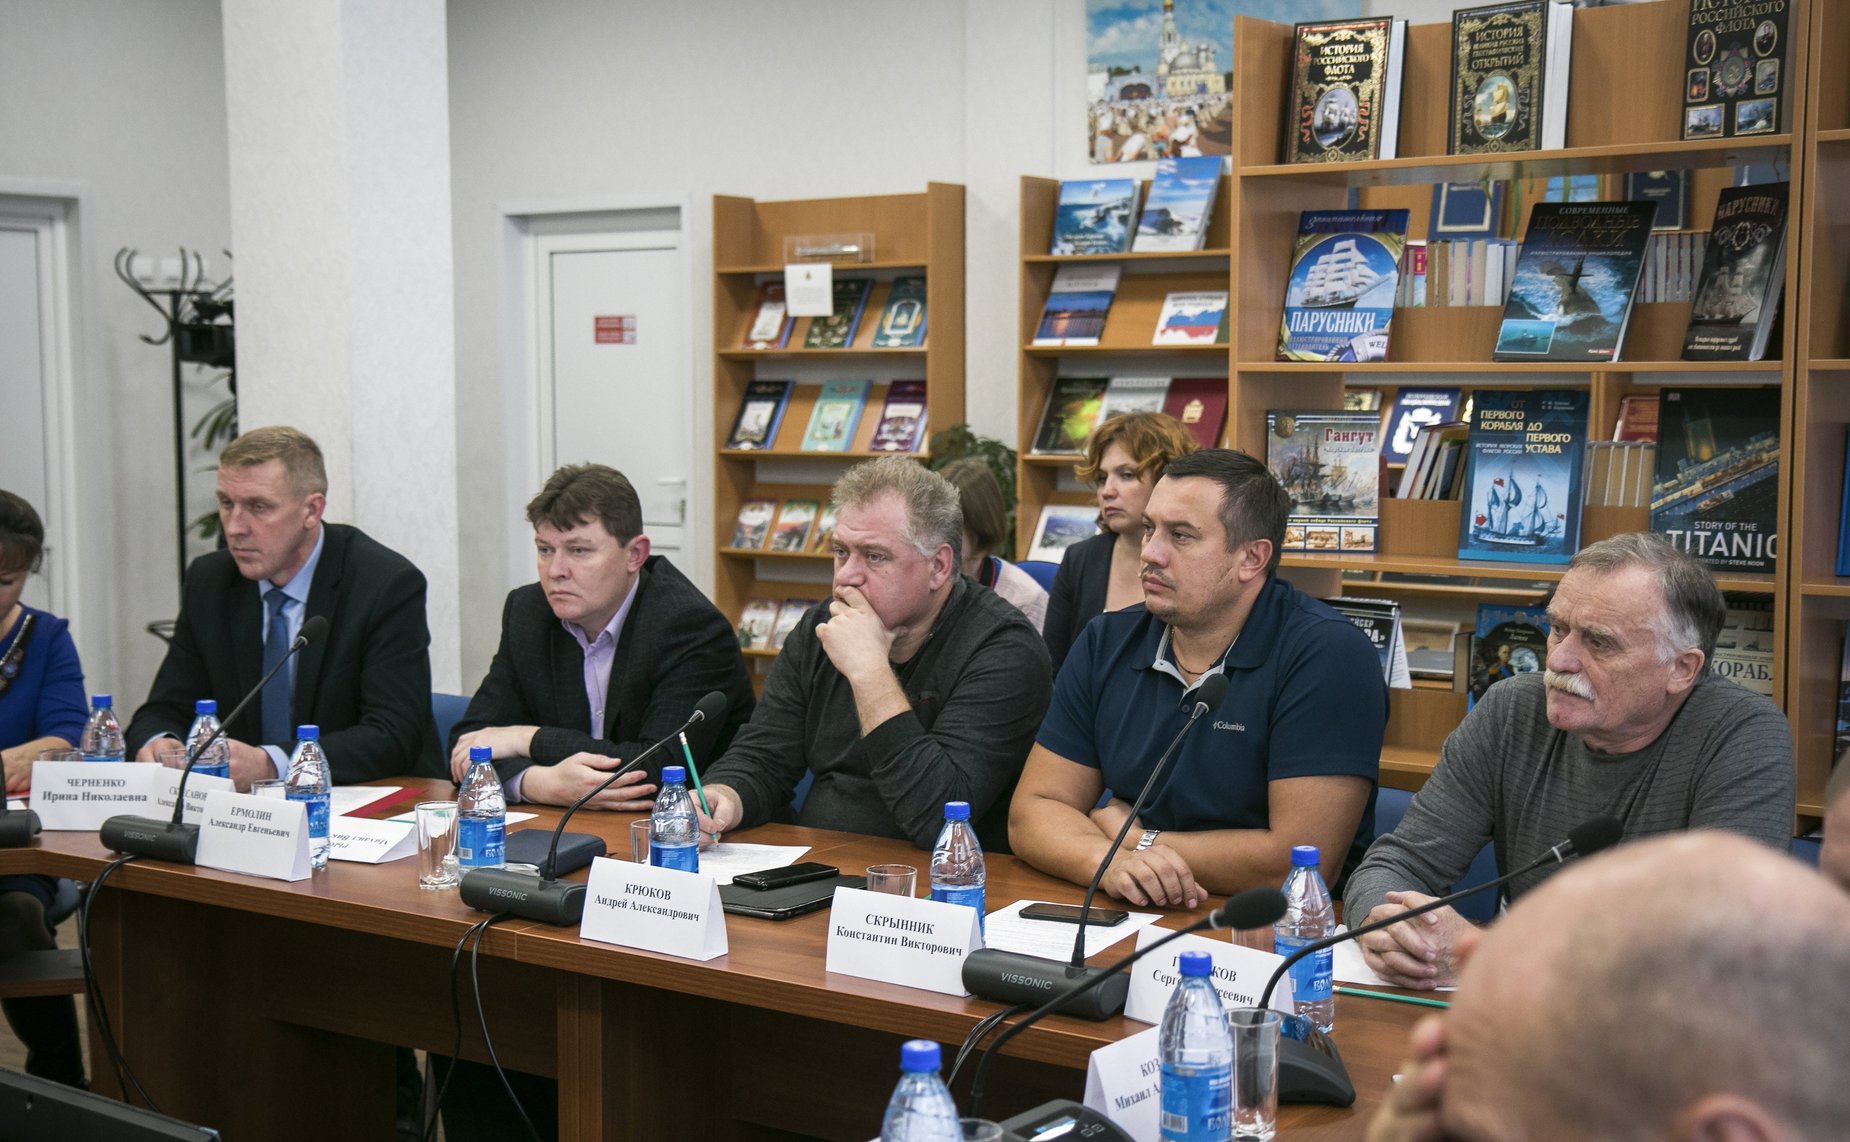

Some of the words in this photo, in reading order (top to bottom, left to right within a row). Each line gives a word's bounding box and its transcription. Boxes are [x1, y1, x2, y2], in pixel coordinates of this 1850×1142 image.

[1691, 1, 1785, 25] РОССИЙСКОГО
[1715, 18, 1756, 33] ФЛОТА
[1475, 26, 1524, 42] ИСТОРИЯ
[1320, 43, 1364, 55] ИСТОРИЯ
[1313, 54, 1369, 65] РОССИЙСКОГО
[1472, 52, 1524, 70] ОТКРЫТИЙ
[1324, 65, 1355, 75] ФЛОТА
[1559, 206, 1629, 215] СОВРЕМЕННЫЕ
[1290, 311, 1376, 333] ПАРУСНИКИ
[1480, 410, 1525, 419] ПЕРВОГО
[1480, 421, 1524, 430] КОРАБЛЯ
[1527, 422, 1543, 431] ДО
[1325, 428, 1374, 446] Гангут
[1526, 433, 1571, 443] ПЕРВОГО
[1525, 444, 1562, 453] УСТАВА
[1694, 521, 1723, 530] STORY
[1725, 522, 1737, 531] OF
[1739, 522, 1757, 532] THE
[1217, 720, 1246, 731] Columbia
[67, 778, 126, 787] ЧЕРНЕНКО
[42, 791, 78, 803] Ирина
[81, 791, 148, 802] Николаевна
[230, 806, 272, 821] ЕРМОЛИН
[208, 818, 246, 833] Александр
[247, 823, 290, 838] Евгеньевич
[489, 887, 528, 901] VISSONIC
[624, 883, 671, 901] КРЮКОВ
[594, 894, 628, 909] Андрей
[629, 901, 700, 922] Александрович
[865, 913, 935, 935] СКРЫННИК
[836, 925, 898, 946] Константин
[900, 936, 962, 957] Викторович
[1001, 972, 1053, 990] VISSONIC
[1115, 1088, 1151, 1112] Михаил
